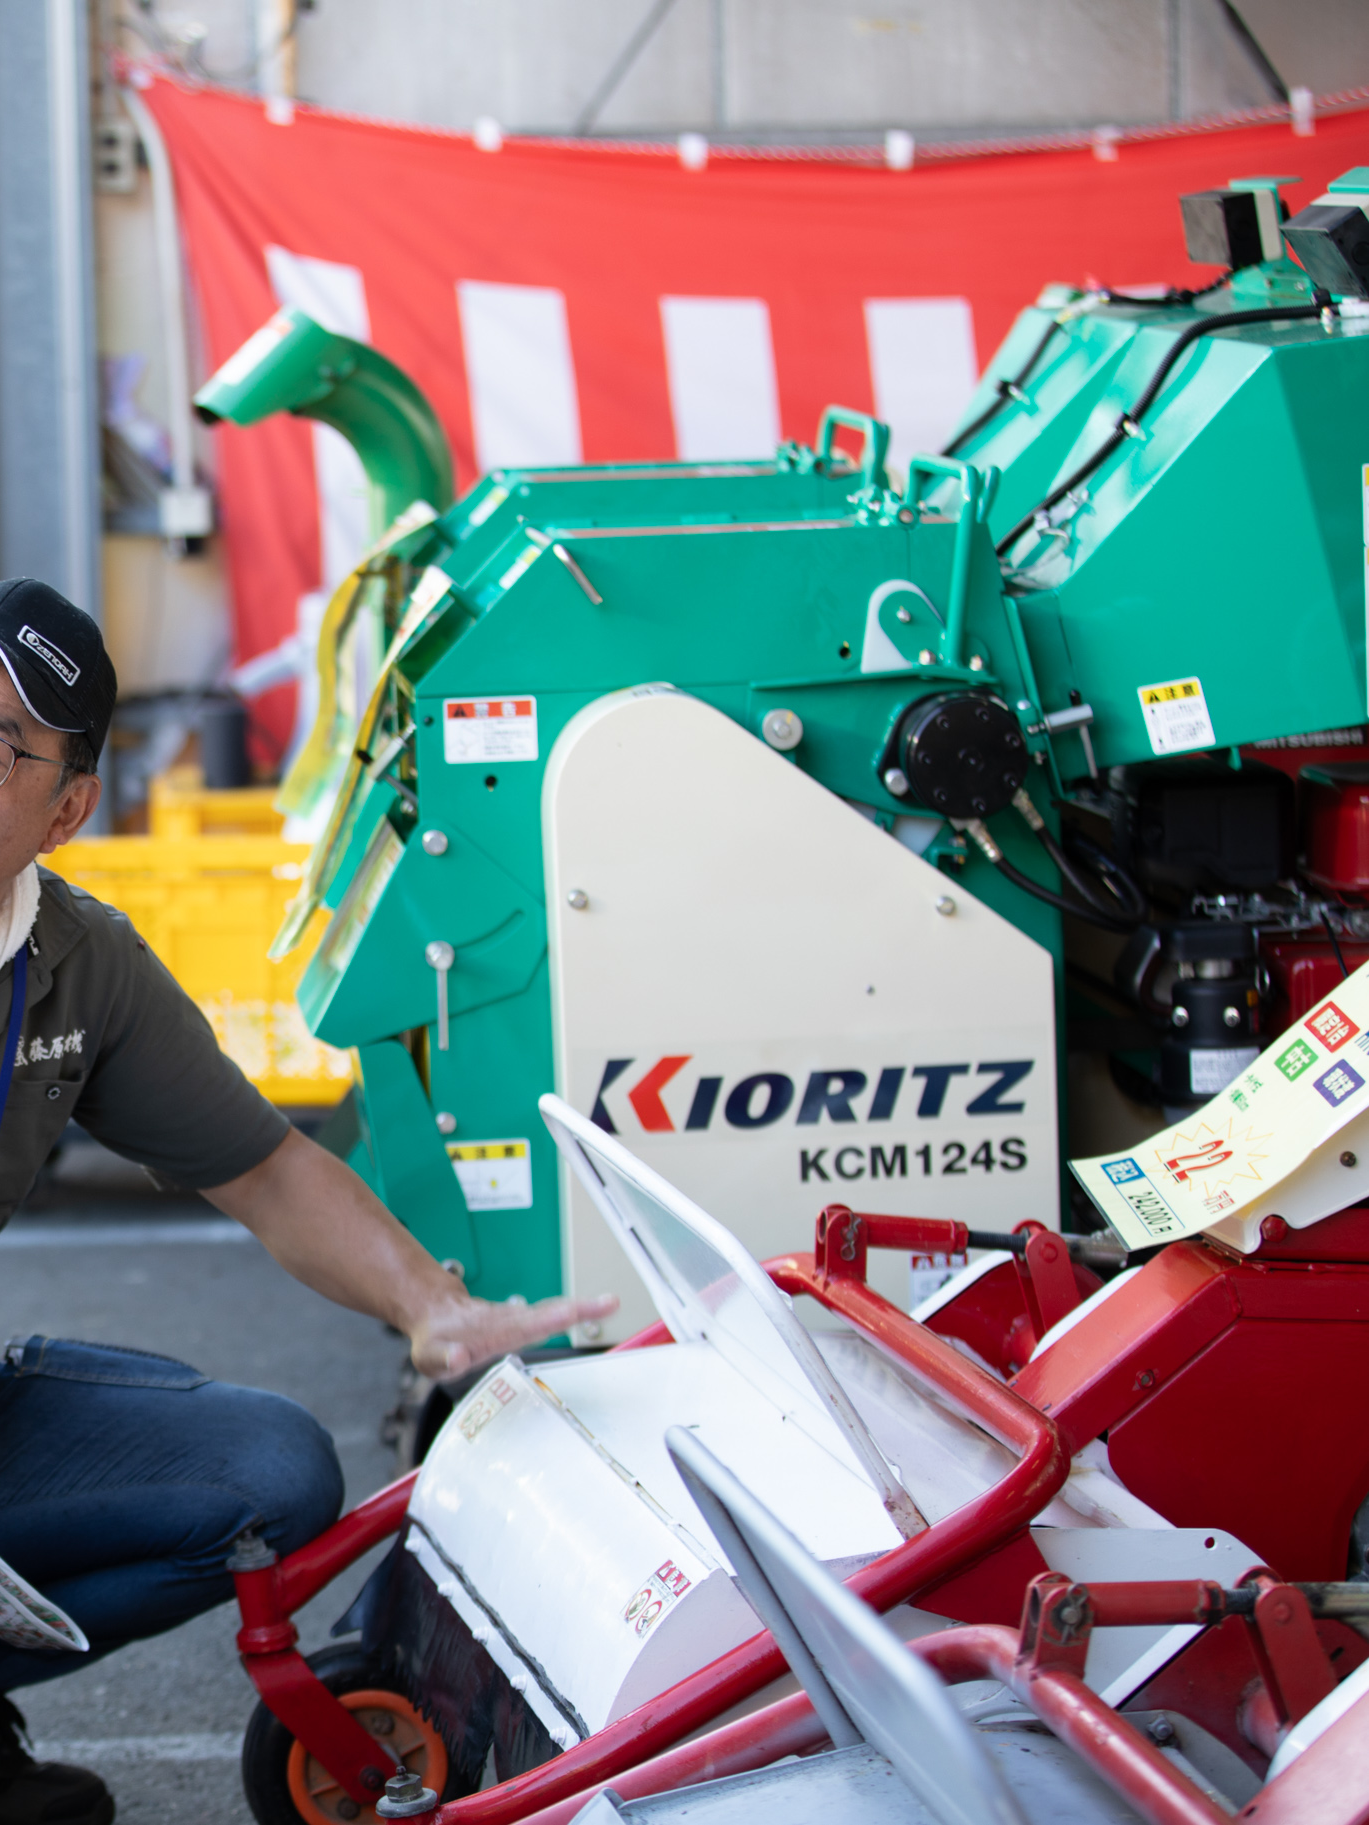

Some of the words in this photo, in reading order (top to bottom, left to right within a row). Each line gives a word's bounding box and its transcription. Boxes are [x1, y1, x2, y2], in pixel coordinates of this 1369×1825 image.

[1281, 1045, 1312, 1077] 中古
[590, 1054, 1036, 1135] KIORITZ
[799, 1137, 1028, 1184] KCM124S
[1164, 1139, 1234, 1184] 22
